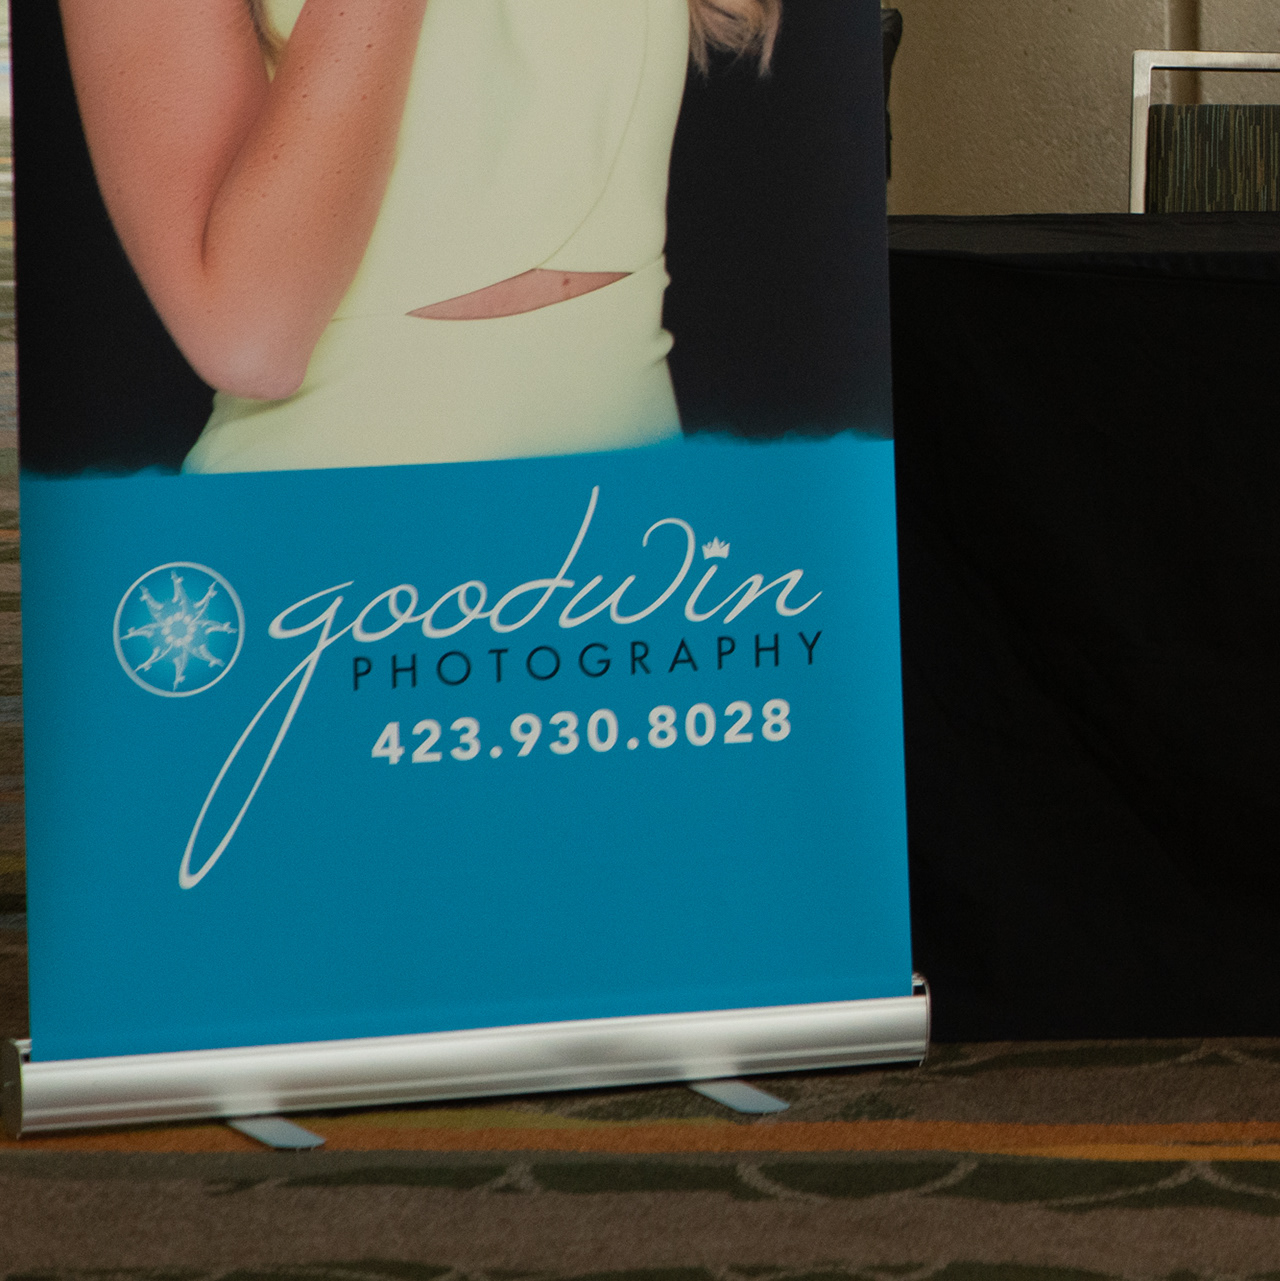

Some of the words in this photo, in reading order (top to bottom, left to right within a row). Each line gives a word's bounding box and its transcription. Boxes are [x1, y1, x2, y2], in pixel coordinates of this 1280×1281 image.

[179, 485, 823, 889] goodwin
[353, 630, 824, 692] PHOTOGRAPHY
[370, 698, 793, 765] 423.930.8028
